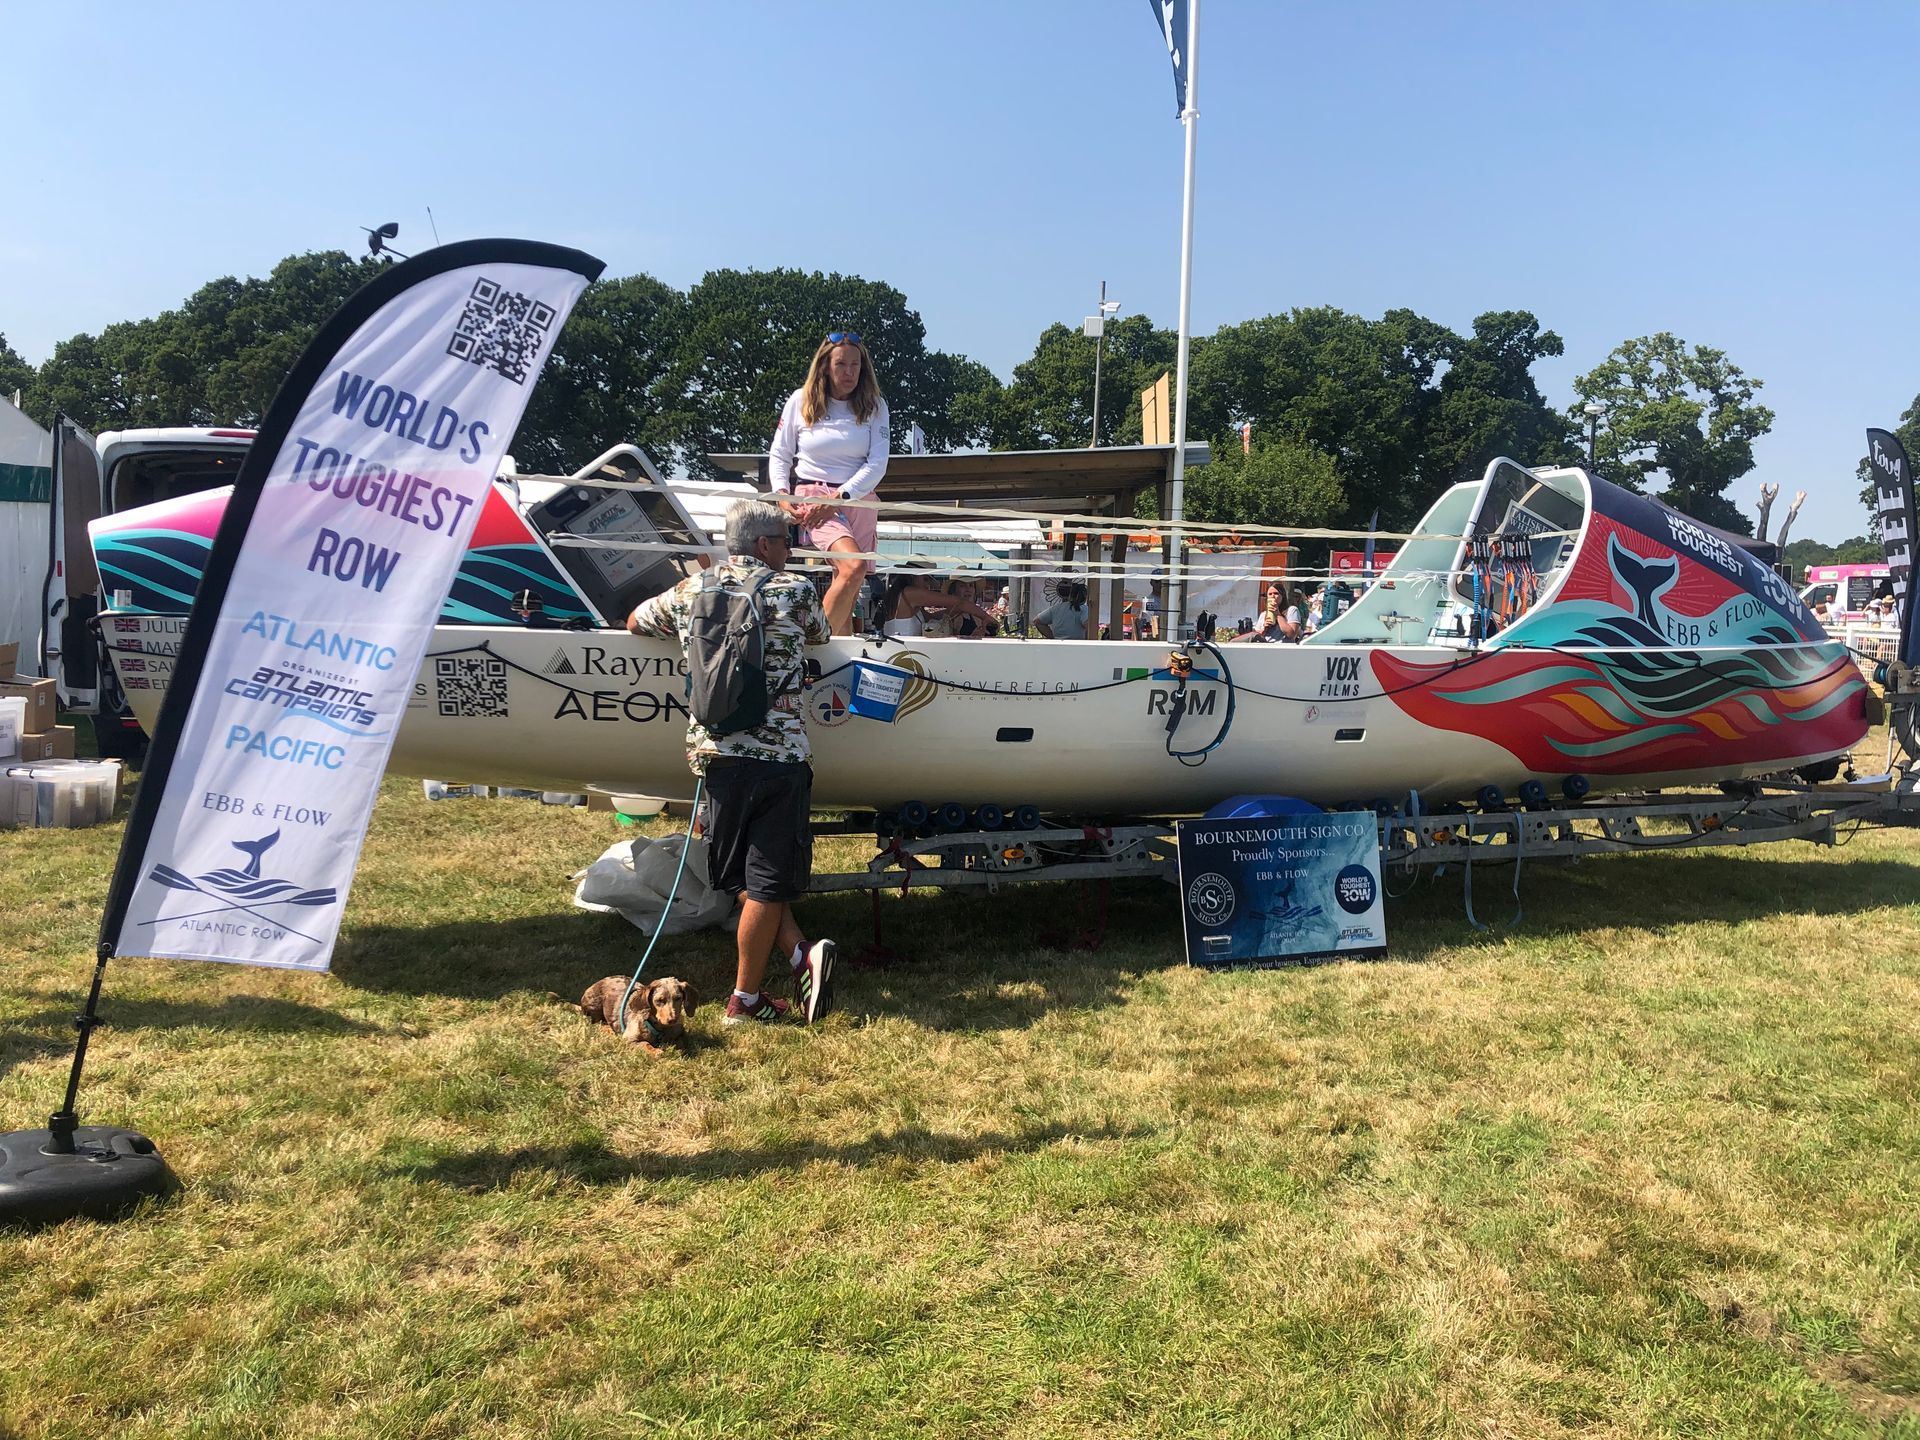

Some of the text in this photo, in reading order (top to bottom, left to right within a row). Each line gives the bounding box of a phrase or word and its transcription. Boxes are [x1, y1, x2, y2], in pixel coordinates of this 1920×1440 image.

[332, 371, 489, 464] WORLD'S
[288, 437, 473, 537] TOUGHEST
[1664, 512, 1732, 556] WORLD'S
[307, 527, 401, 593] ROW
[1668, 524, 1744, 576] TOUGHEST
[1667, 600, 1766, 646] EBB & FLOW
[241, 611, 397, 670] ATLANTIC
[282, 660, 346, 683] ORGANIZED
[1327, 657, 1361, 681] VOX
[947, 680, 1079, 693] SOVEREIGN
[1319, 684, 1360, 697] FILMS
[554, 689, 691, 723] AEON
[1147, 688, 1217, 716] RSM
[225, 724, 346, 770] PACIFIC
[201, 791, 332, 827] EBB & FLOW
[1194, 827, 1307, 846] BOURNEMOUTH
[1310, 825, 1342, 839] SIGN
[1232, 846, 1336, 863] Proudly Sponsors...
[1256, 869, 1309, 881] EBB & FLOW
[1340, 882, 1371, 890] TOUGHEST
[1341, 876, 1369, 884] WORLD'S
[1191, 874, 1232, 904] BOURNEMOUTH
[1340, 888, 1371, 902] ROW
[179, 919, 287, 942] ATLANTIC ROW
[1198, 911, 1217, 924] SIGN
